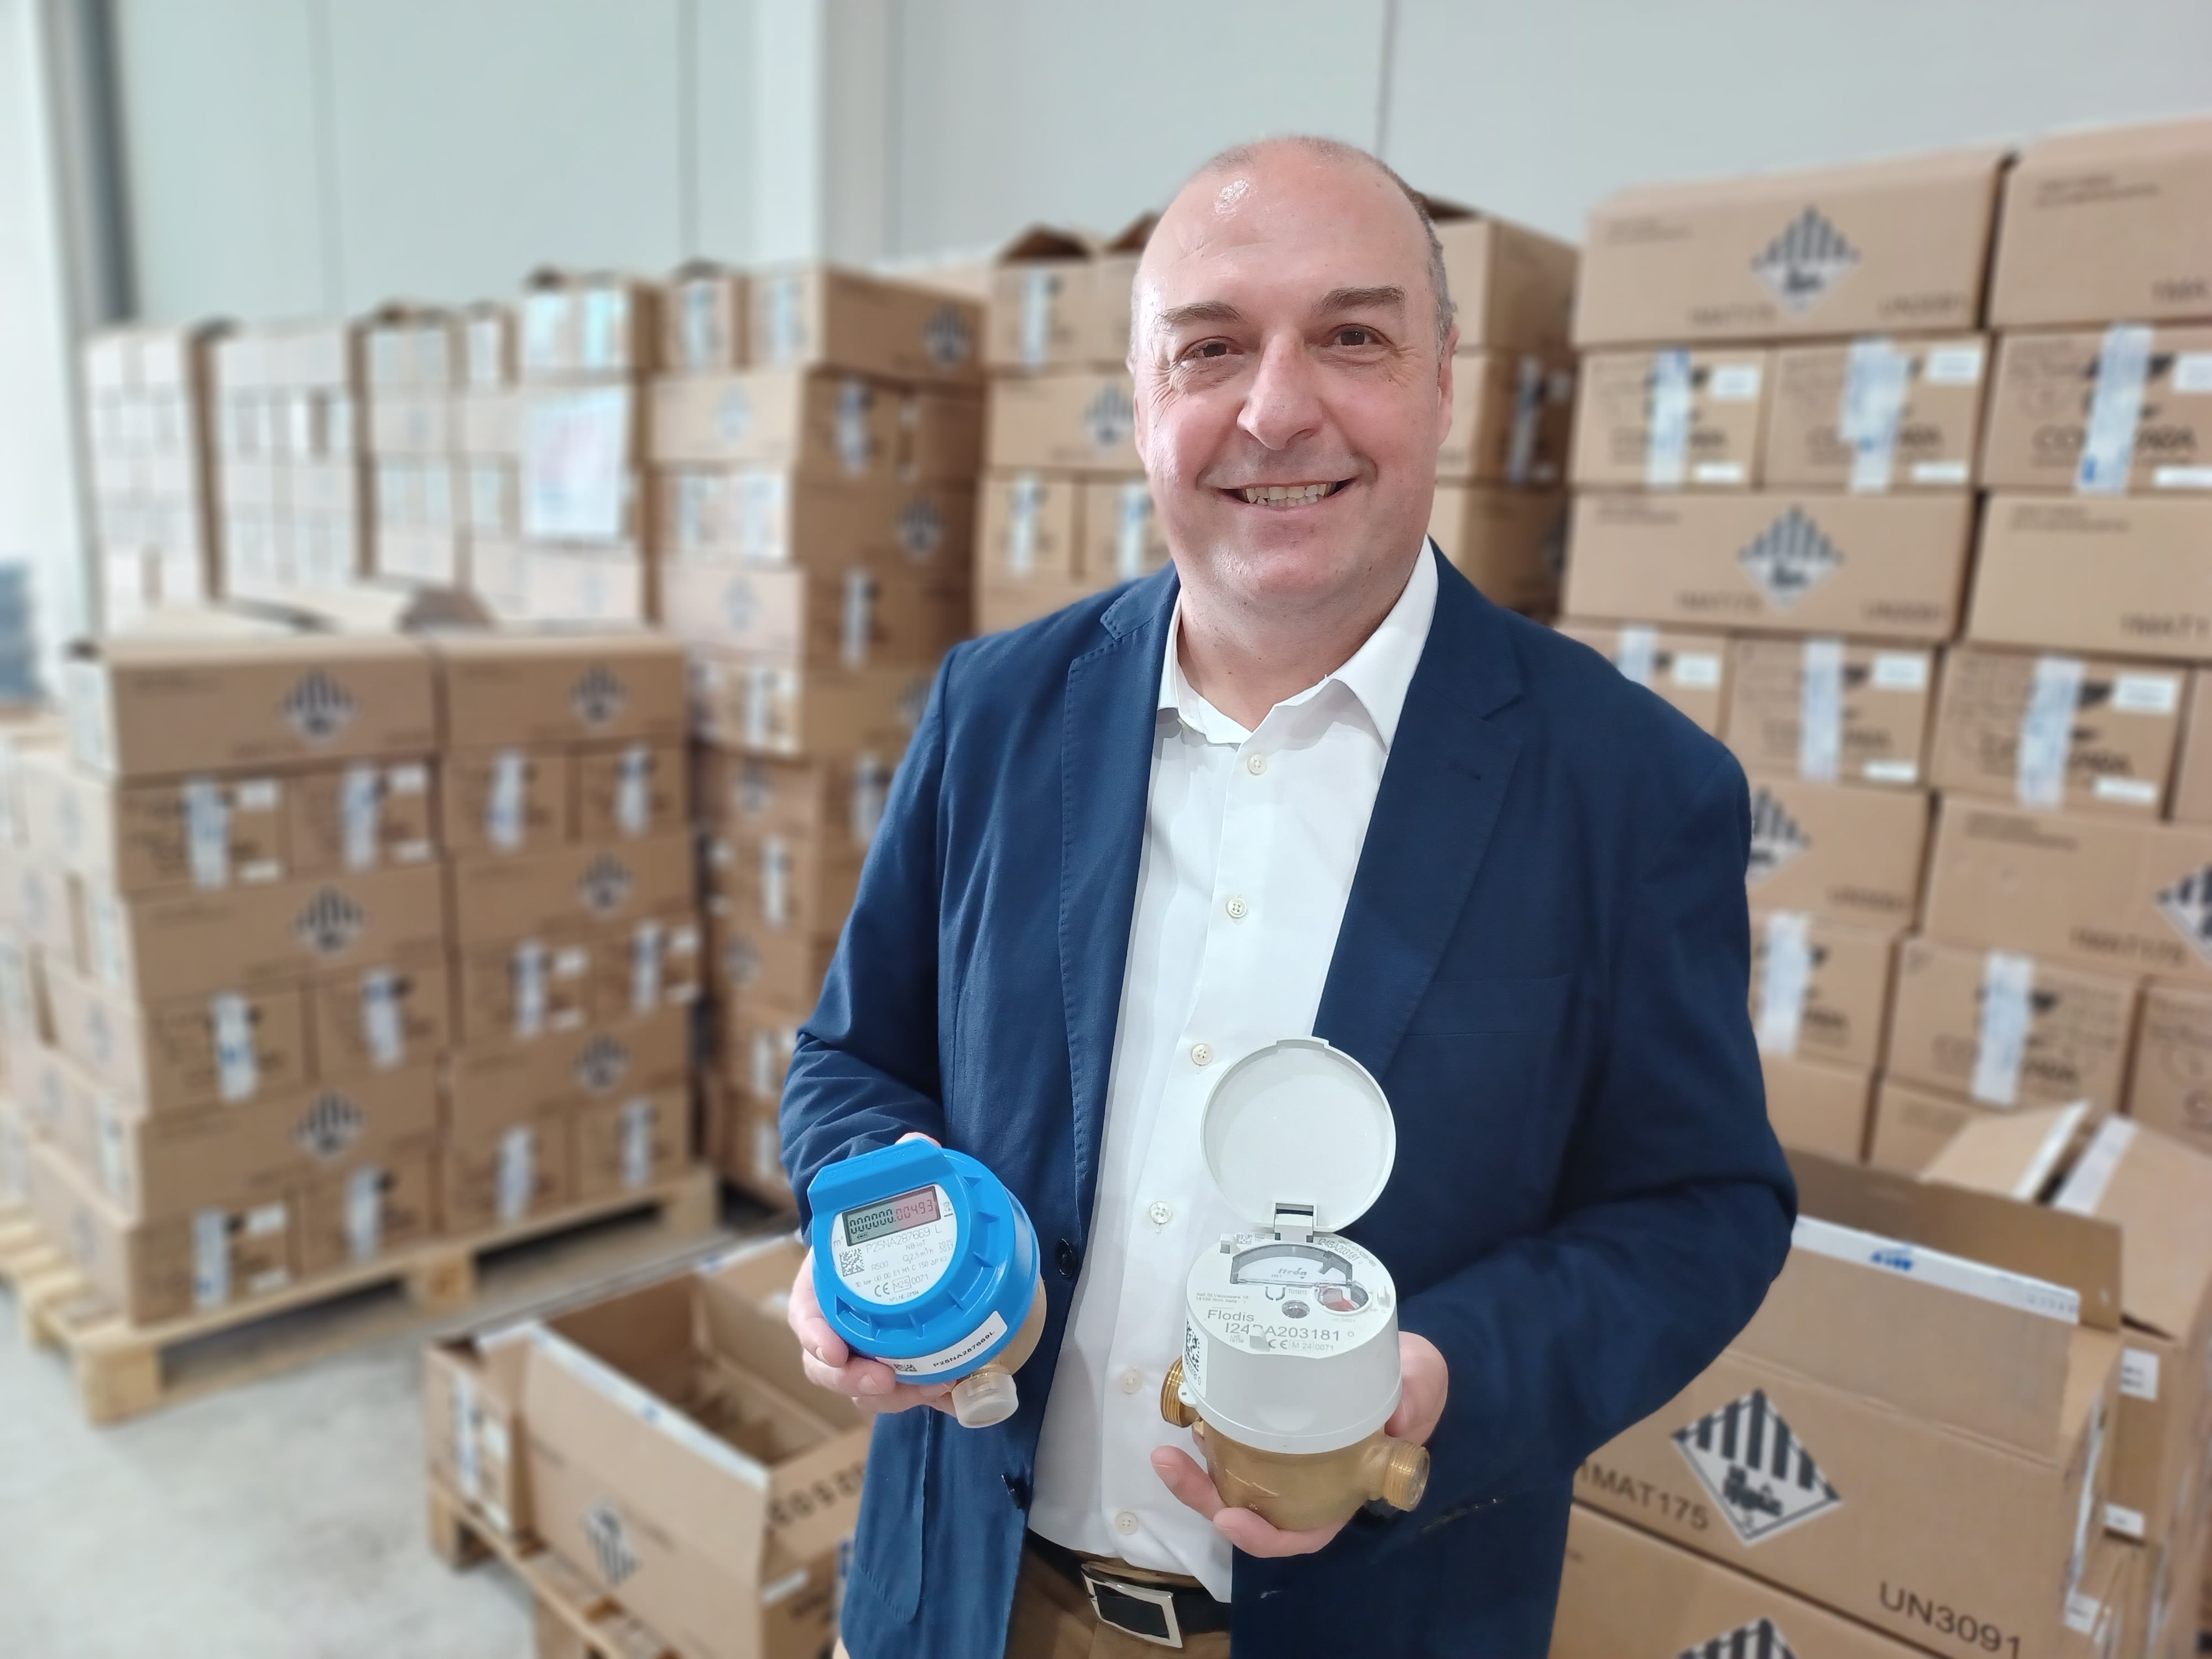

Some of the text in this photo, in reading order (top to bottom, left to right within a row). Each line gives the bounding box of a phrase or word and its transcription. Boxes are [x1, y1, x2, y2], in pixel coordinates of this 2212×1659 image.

[866, 1227, 930, 1253] P25NA287669
[872, 1261, 889, 1271] R500
[911, 1274, 929, 1285] 0071
[1208, 1310, 1255, 1322] Flodis
[1225, 1322, 1339, 1341] I24A203181
[1582, 1463, 1710, 1531] 1MAT175
[1879, 1580, 2021, 1659] UN3091
